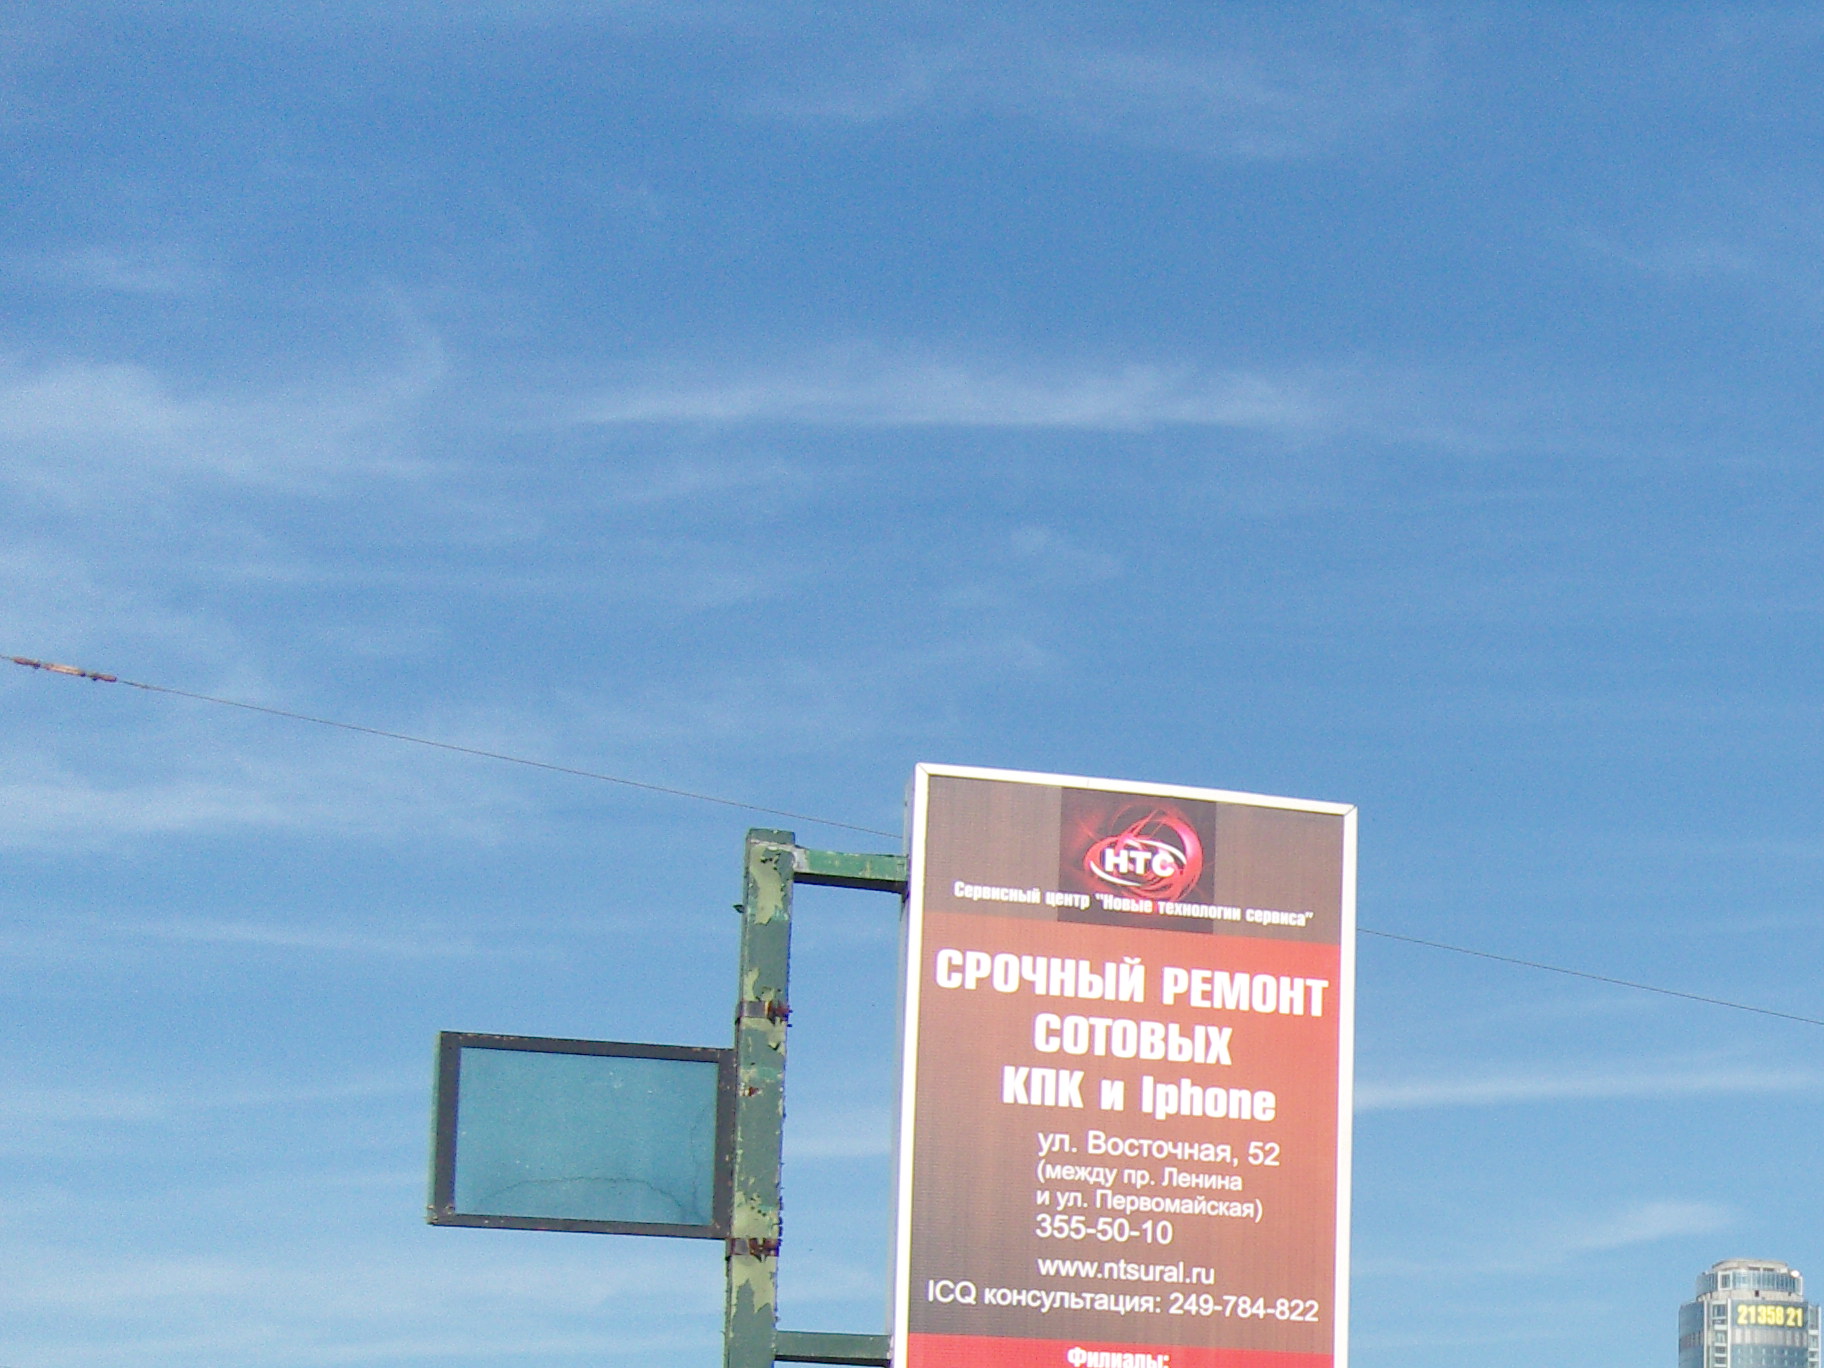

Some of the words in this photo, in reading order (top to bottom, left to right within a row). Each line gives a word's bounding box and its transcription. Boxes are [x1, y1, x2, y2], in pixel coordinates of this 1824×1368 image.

[1104, 847, 1175, 878] НТС
[954, 880, 1041, 905] Сервисный
[1045, 892, 1090, 910] центр
[1095, 894, 1152, 913] "Новые
[1158, 900, 1241, 921] технологии
[1245, 906, 1314, 927] сервиса"
[934, 948, 1145, 1003] СРОЧНЫЙ
[1162, 967, 1329, 1017] РЕМОНТ
[1033, 1012, 1233, 1065] СОТОВЫХ
[1002, 1066, 1085, 1109] КПК
[1100, 1079, 1124, 1111] и
[1141, 1075, 1276, 1120] Iphone
[1037, 1132, 1077, 1156] ул.
[1087, 1132, 1239, 1167] Восточная,
[1248, 1143, 1280, 1166] 52
[1036, 1163, 1117, 1187] (между
[1124, 1171, 1156, 1189] пр.
[1162, 1169, 1242, 1191] Ленина
[1036, 1191, 1049, 1206] и
[1056, 1193, 1088, 1210] ул.
[1095, 1191, 1263, 1222] Первомайская)
[1036, 1215, 1174, 1244] 355-50-10
[1038, 1256, 1215, 1285] www.ntsural.ru
[928, 1281, 976, 1305] ICQ
[984, 1289, 1162, 1315] консультация:
[1169, 1294, 1319, 1322] 249-784-822
